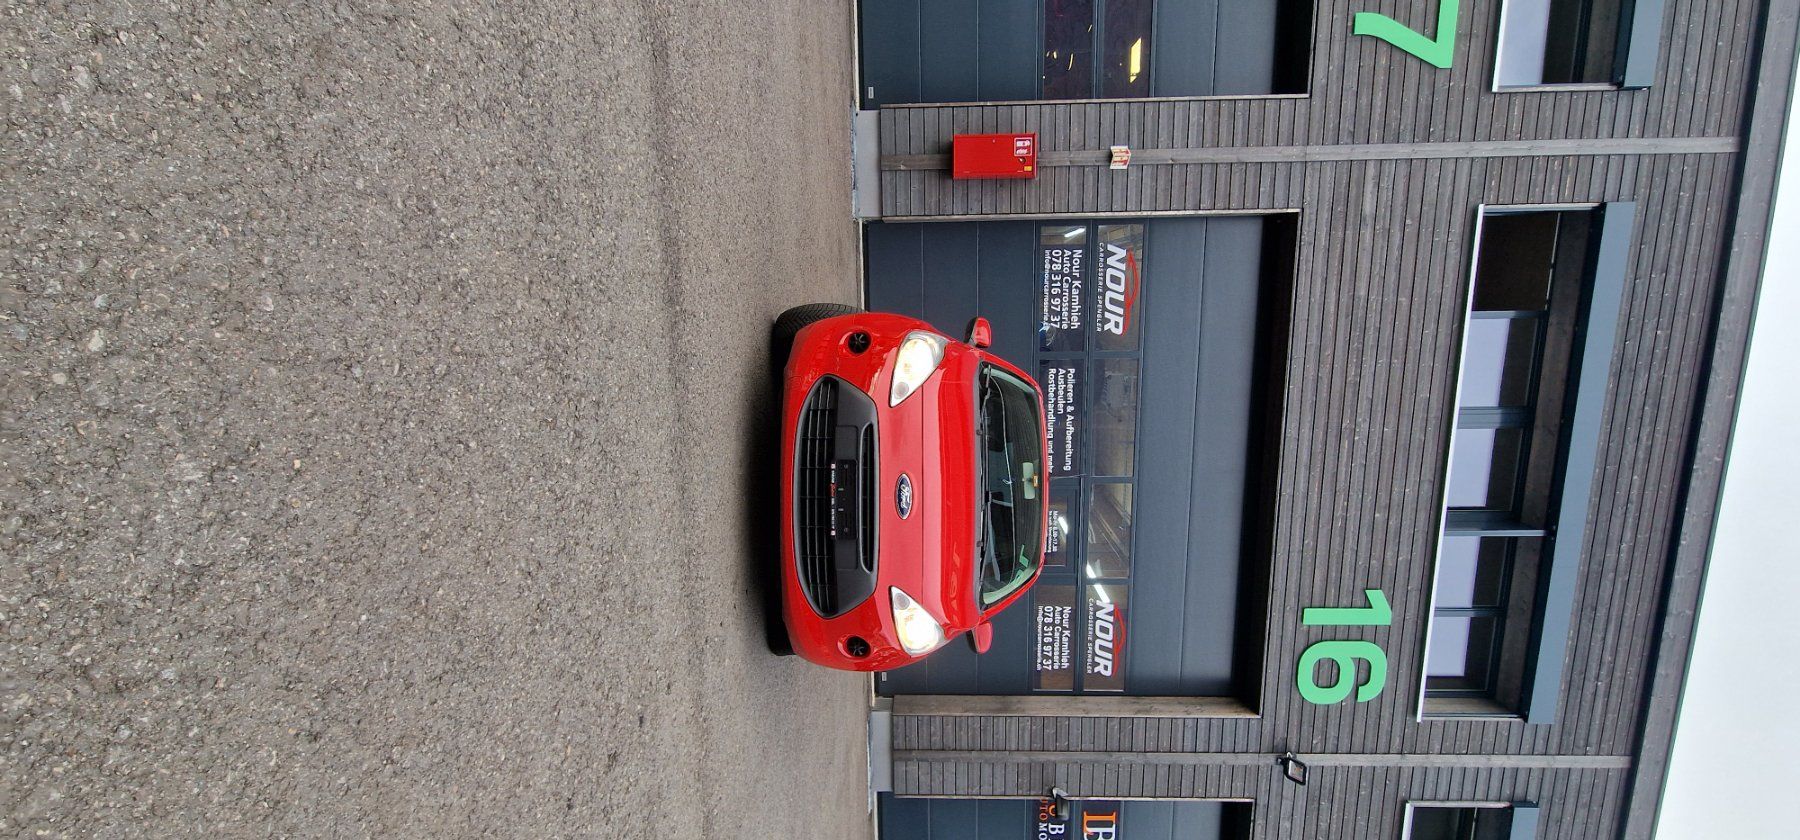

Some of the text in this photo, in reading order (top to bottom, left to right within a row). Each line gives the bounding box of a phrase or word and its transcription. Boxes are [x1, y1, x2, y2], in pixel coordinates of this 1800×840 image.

[1050, 249, 1062, 328] 078 316 97 37
[1062, 249, 1071, 329] Auto Carrosserie
[1071, 249, 1082, 329] Nour Kamhieh
[1104, 244, 1126, 335] NOUR
[1047, 368, 1056, 439] Rostbehandlung
[1057, 368, 1066, 414] Ausbeulen
[1067, 368, 1075, 403] Polieren
[1063, 414, 1074, 471] Aufbereitung
[900, 484, 910, 509] Ford
[1043, 606, 1053, 670] 078 316 97 37
[1053, 626, 1062, 669] Carrosserie
[1061, 606, 1071, 668] Nour Kamhieh
[1094, 600, 1114, 676] NOUR
[1296, 589, 1392, 705] 16
